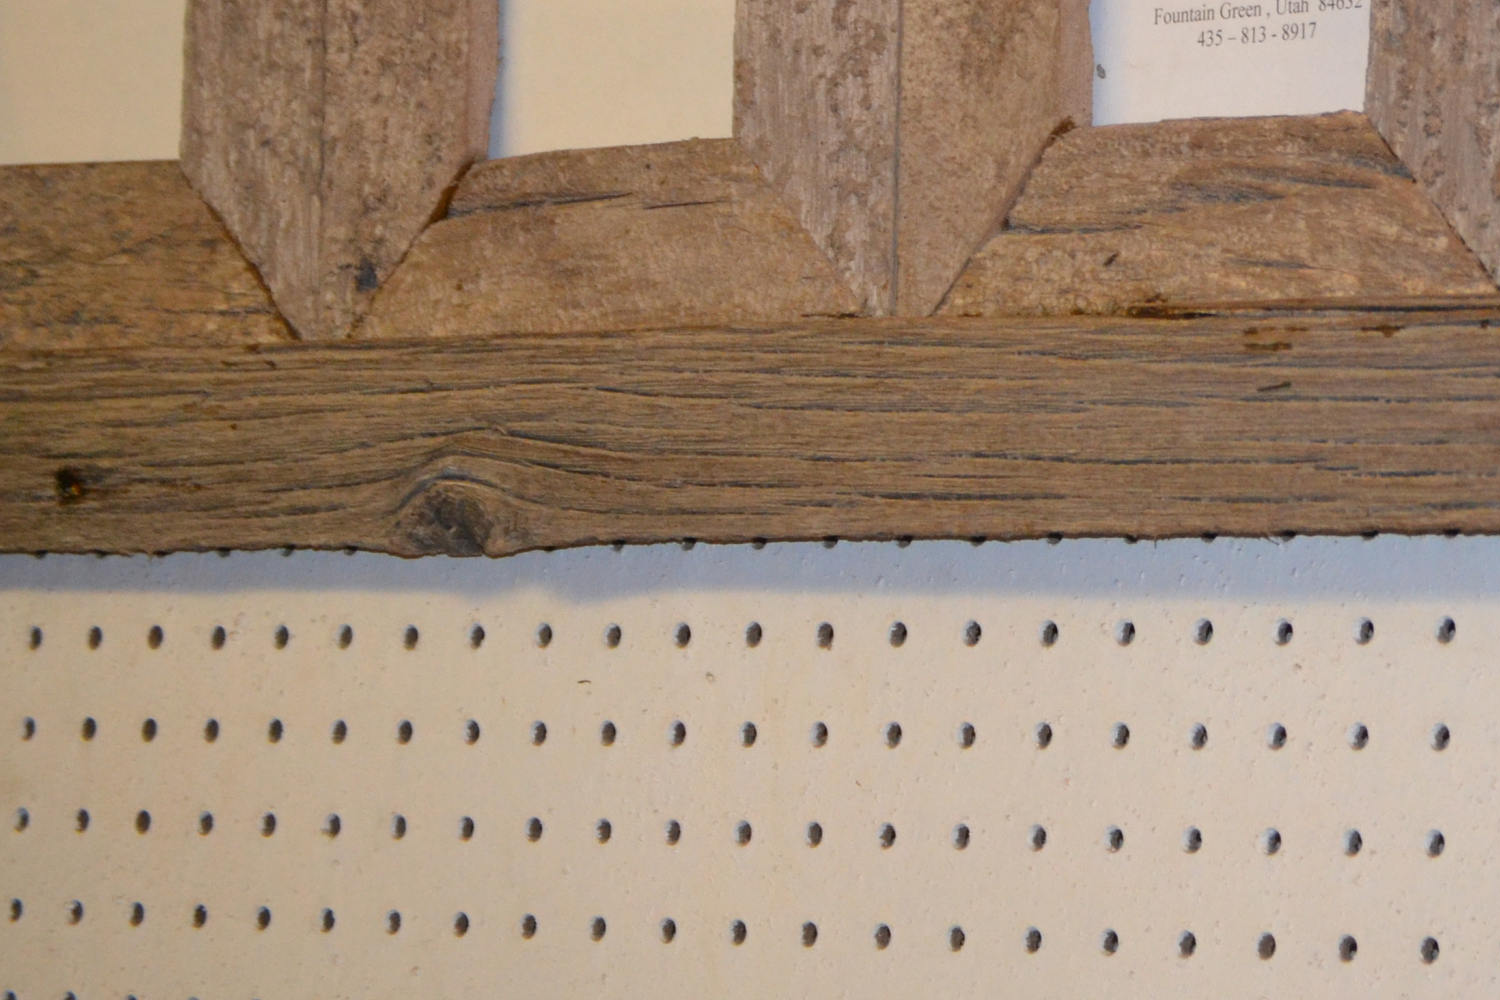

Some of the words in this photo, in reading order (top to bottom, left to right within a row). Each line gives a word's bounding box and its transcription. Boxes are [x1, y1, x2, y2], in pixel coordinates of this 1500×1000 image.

[1153, 3, 1215, 26] Fountain
[1219, 0, 1262, 20] Green
[1197, 29, 1223, 48] 435
[1240, 26, 1267, 45] 813
[1281, 22, 1317, 42] 8917
